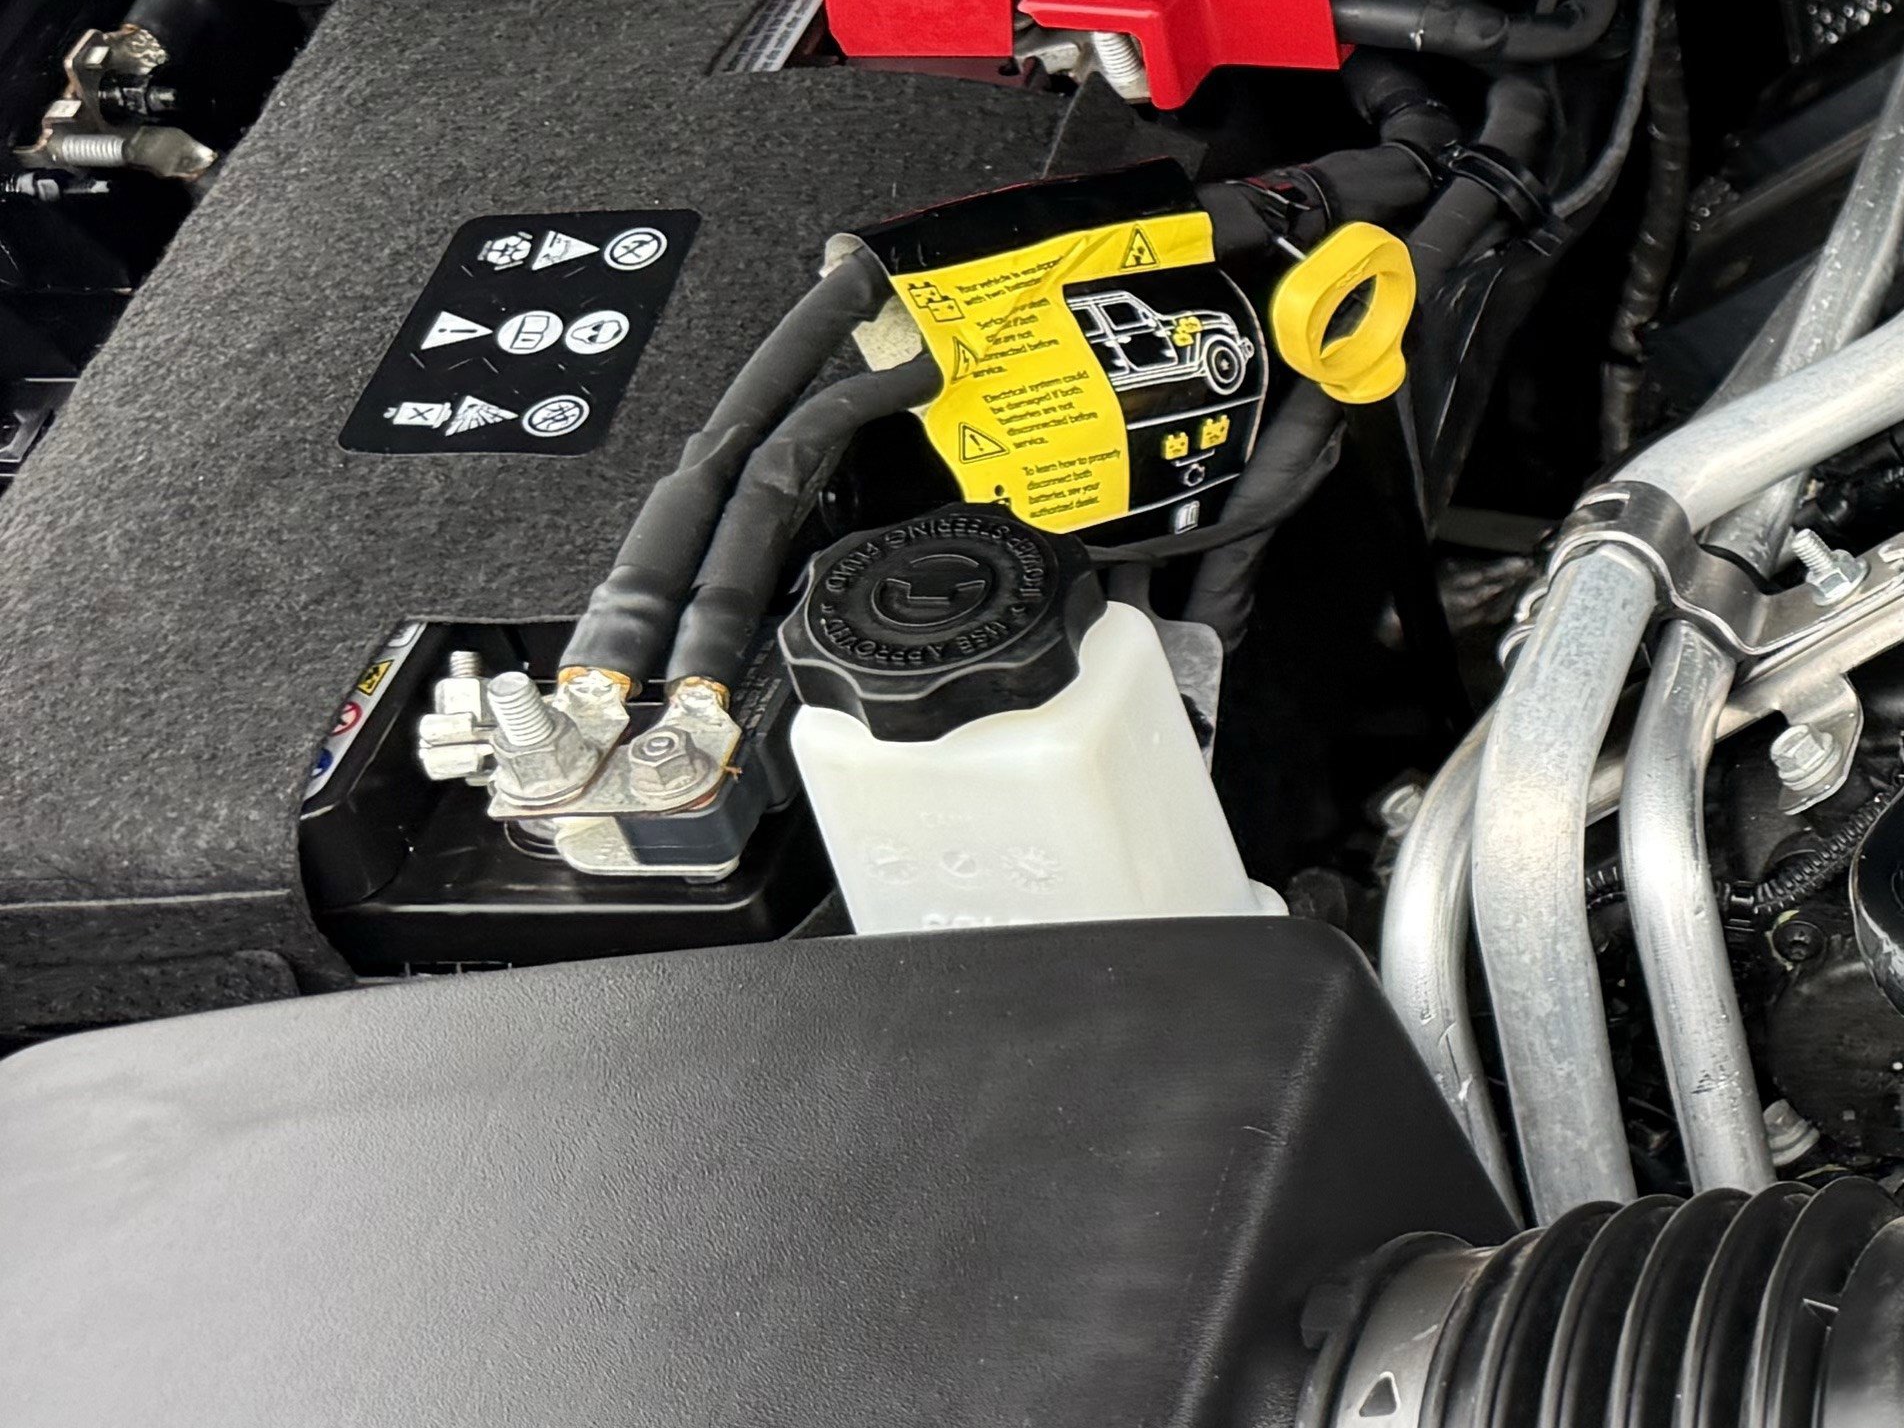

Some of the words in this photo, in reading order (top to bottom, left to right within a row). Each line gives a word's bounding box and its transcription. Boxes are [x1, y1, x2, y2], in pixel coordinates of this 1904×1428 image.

[980, 274, 1011, 290] vehicle
[964, 294, 986, 306] with
[1029, 337, 1060, 351] before
[982, 385, 1027, 403] Electrical
[1029, 376, 1062, 392] system
[1062, 370, 1089, 383] could
[1006, 393, 1050, 411] damaged
[997, 410, 1041, 425] batteries
[1007, 417, 1068, 436] disconnected
[1070, 411, 1098, 424] before
[1088, 449, 1121, 464] properly
[1027, 473, 1071, 491] disconnect
[1030, 501, 1073, 518] authorized
[884, 518, 1010, 549] STEERING
[825, 542, 879, 592] FLUID
[1007, 537, 1046, 600] POWER
[821, 618, 945, 666] APPROVED
[955, 621, 1008, 653] USE
